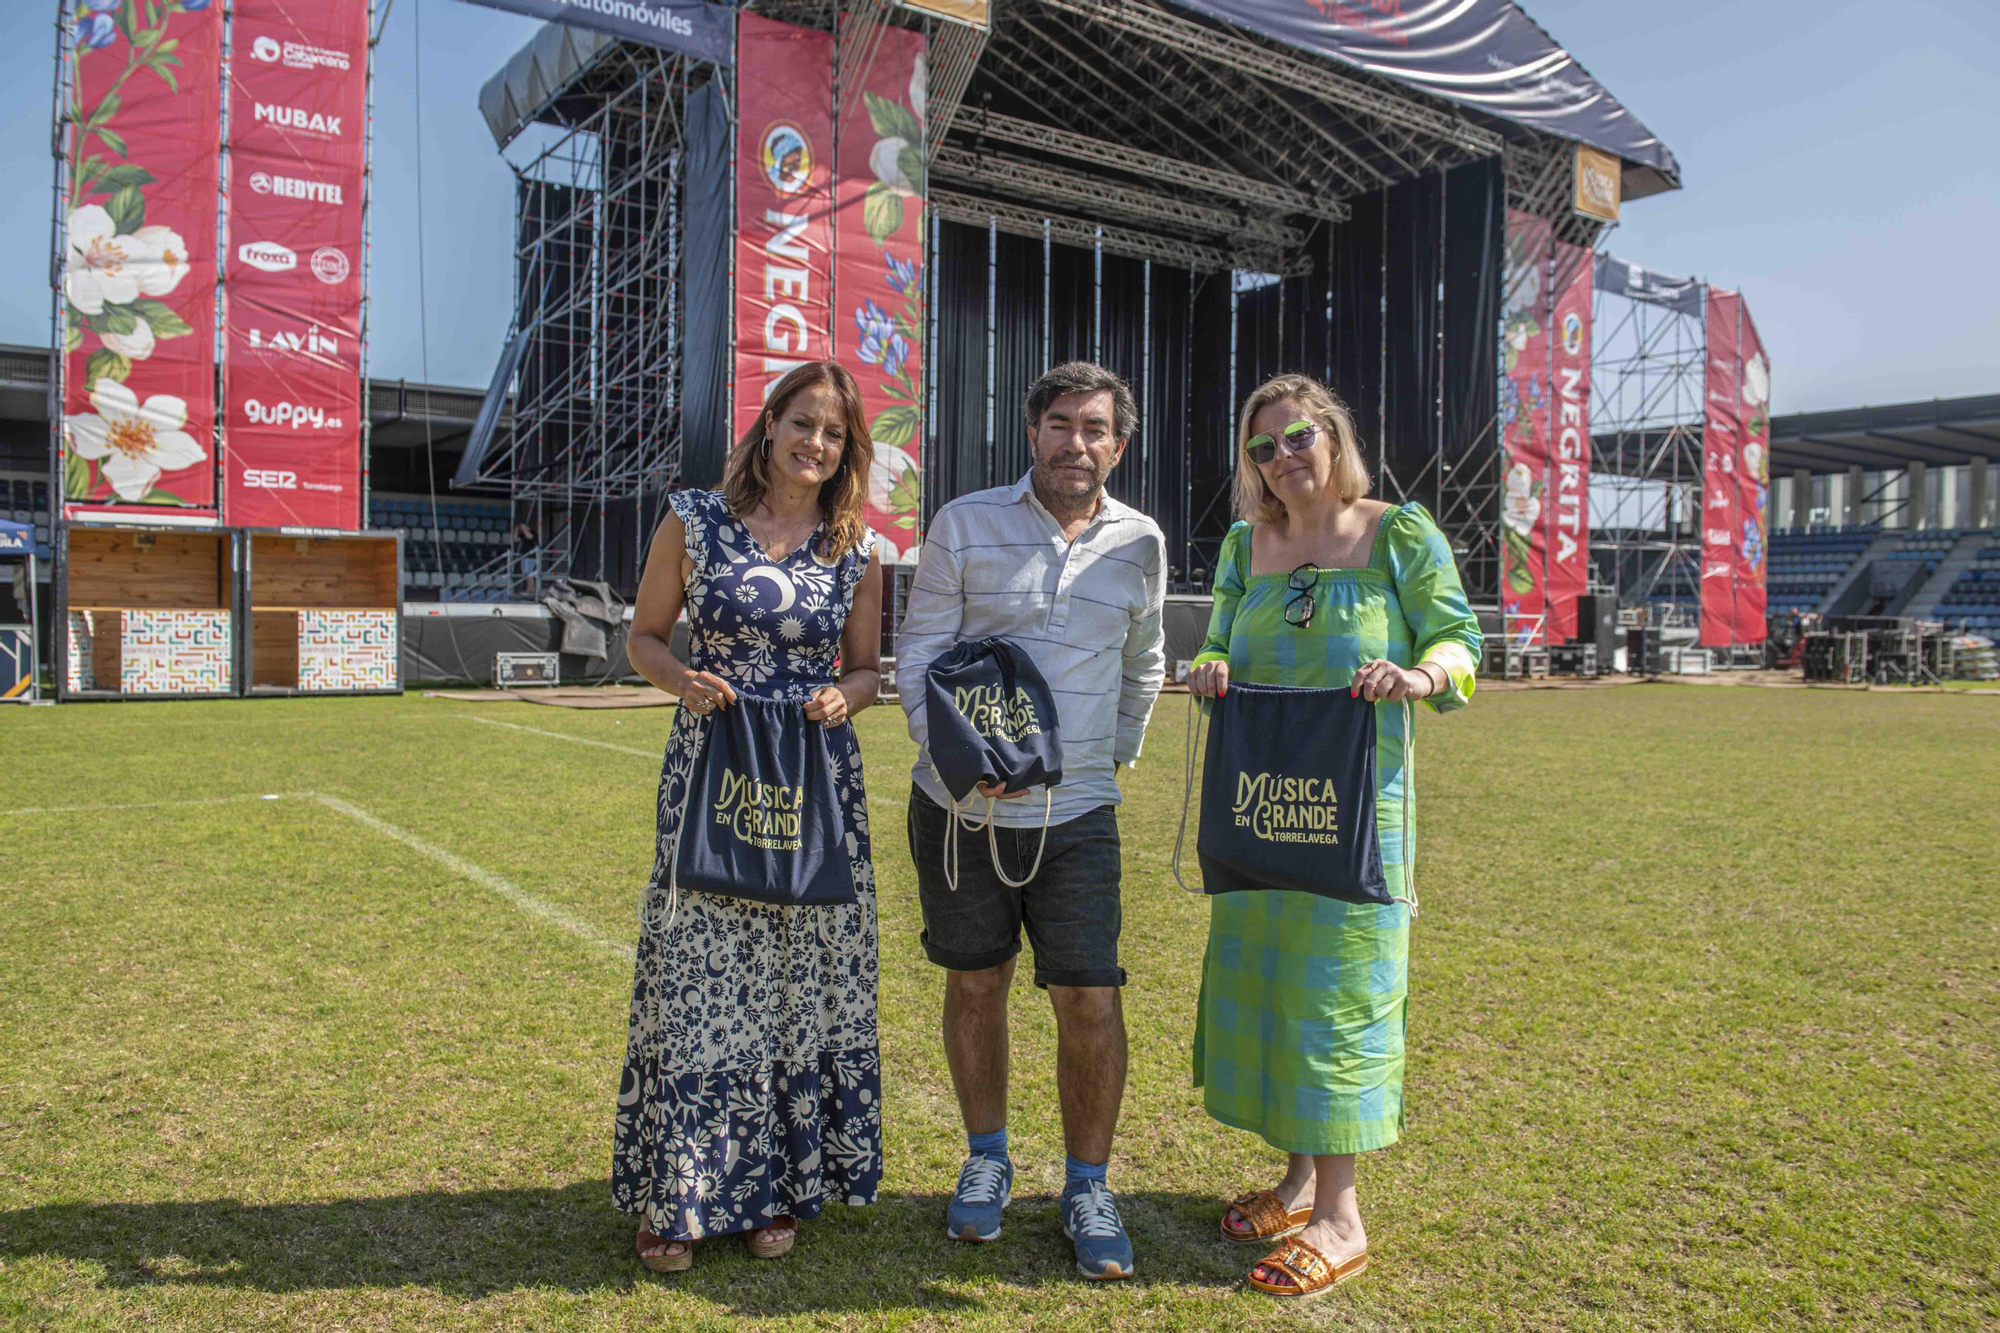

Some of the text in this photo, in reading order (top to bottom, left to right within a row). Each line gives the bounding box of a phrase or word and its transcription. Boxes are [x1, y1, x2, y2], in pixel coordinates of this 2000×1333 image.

[561, 0, 692, 36] utomóviles
[254, 102, 342, 136] MUBAK
[273, 175, 343, 206] REDYTEL
[246, 248, 291, 266] froxa
[243, 469, 297, 490] SER
[1556, 367, 1583, 563] NEGRITA
[714, 767, 803, 811] MÚSICA
[1232, 770, 1338, 813] MÚSICA
[716, 812, 732, 825] EN
[1235, 800, 1339, 842] EN GRANDE
[1274, 832, 1339, 845] TORRELAVEGA
